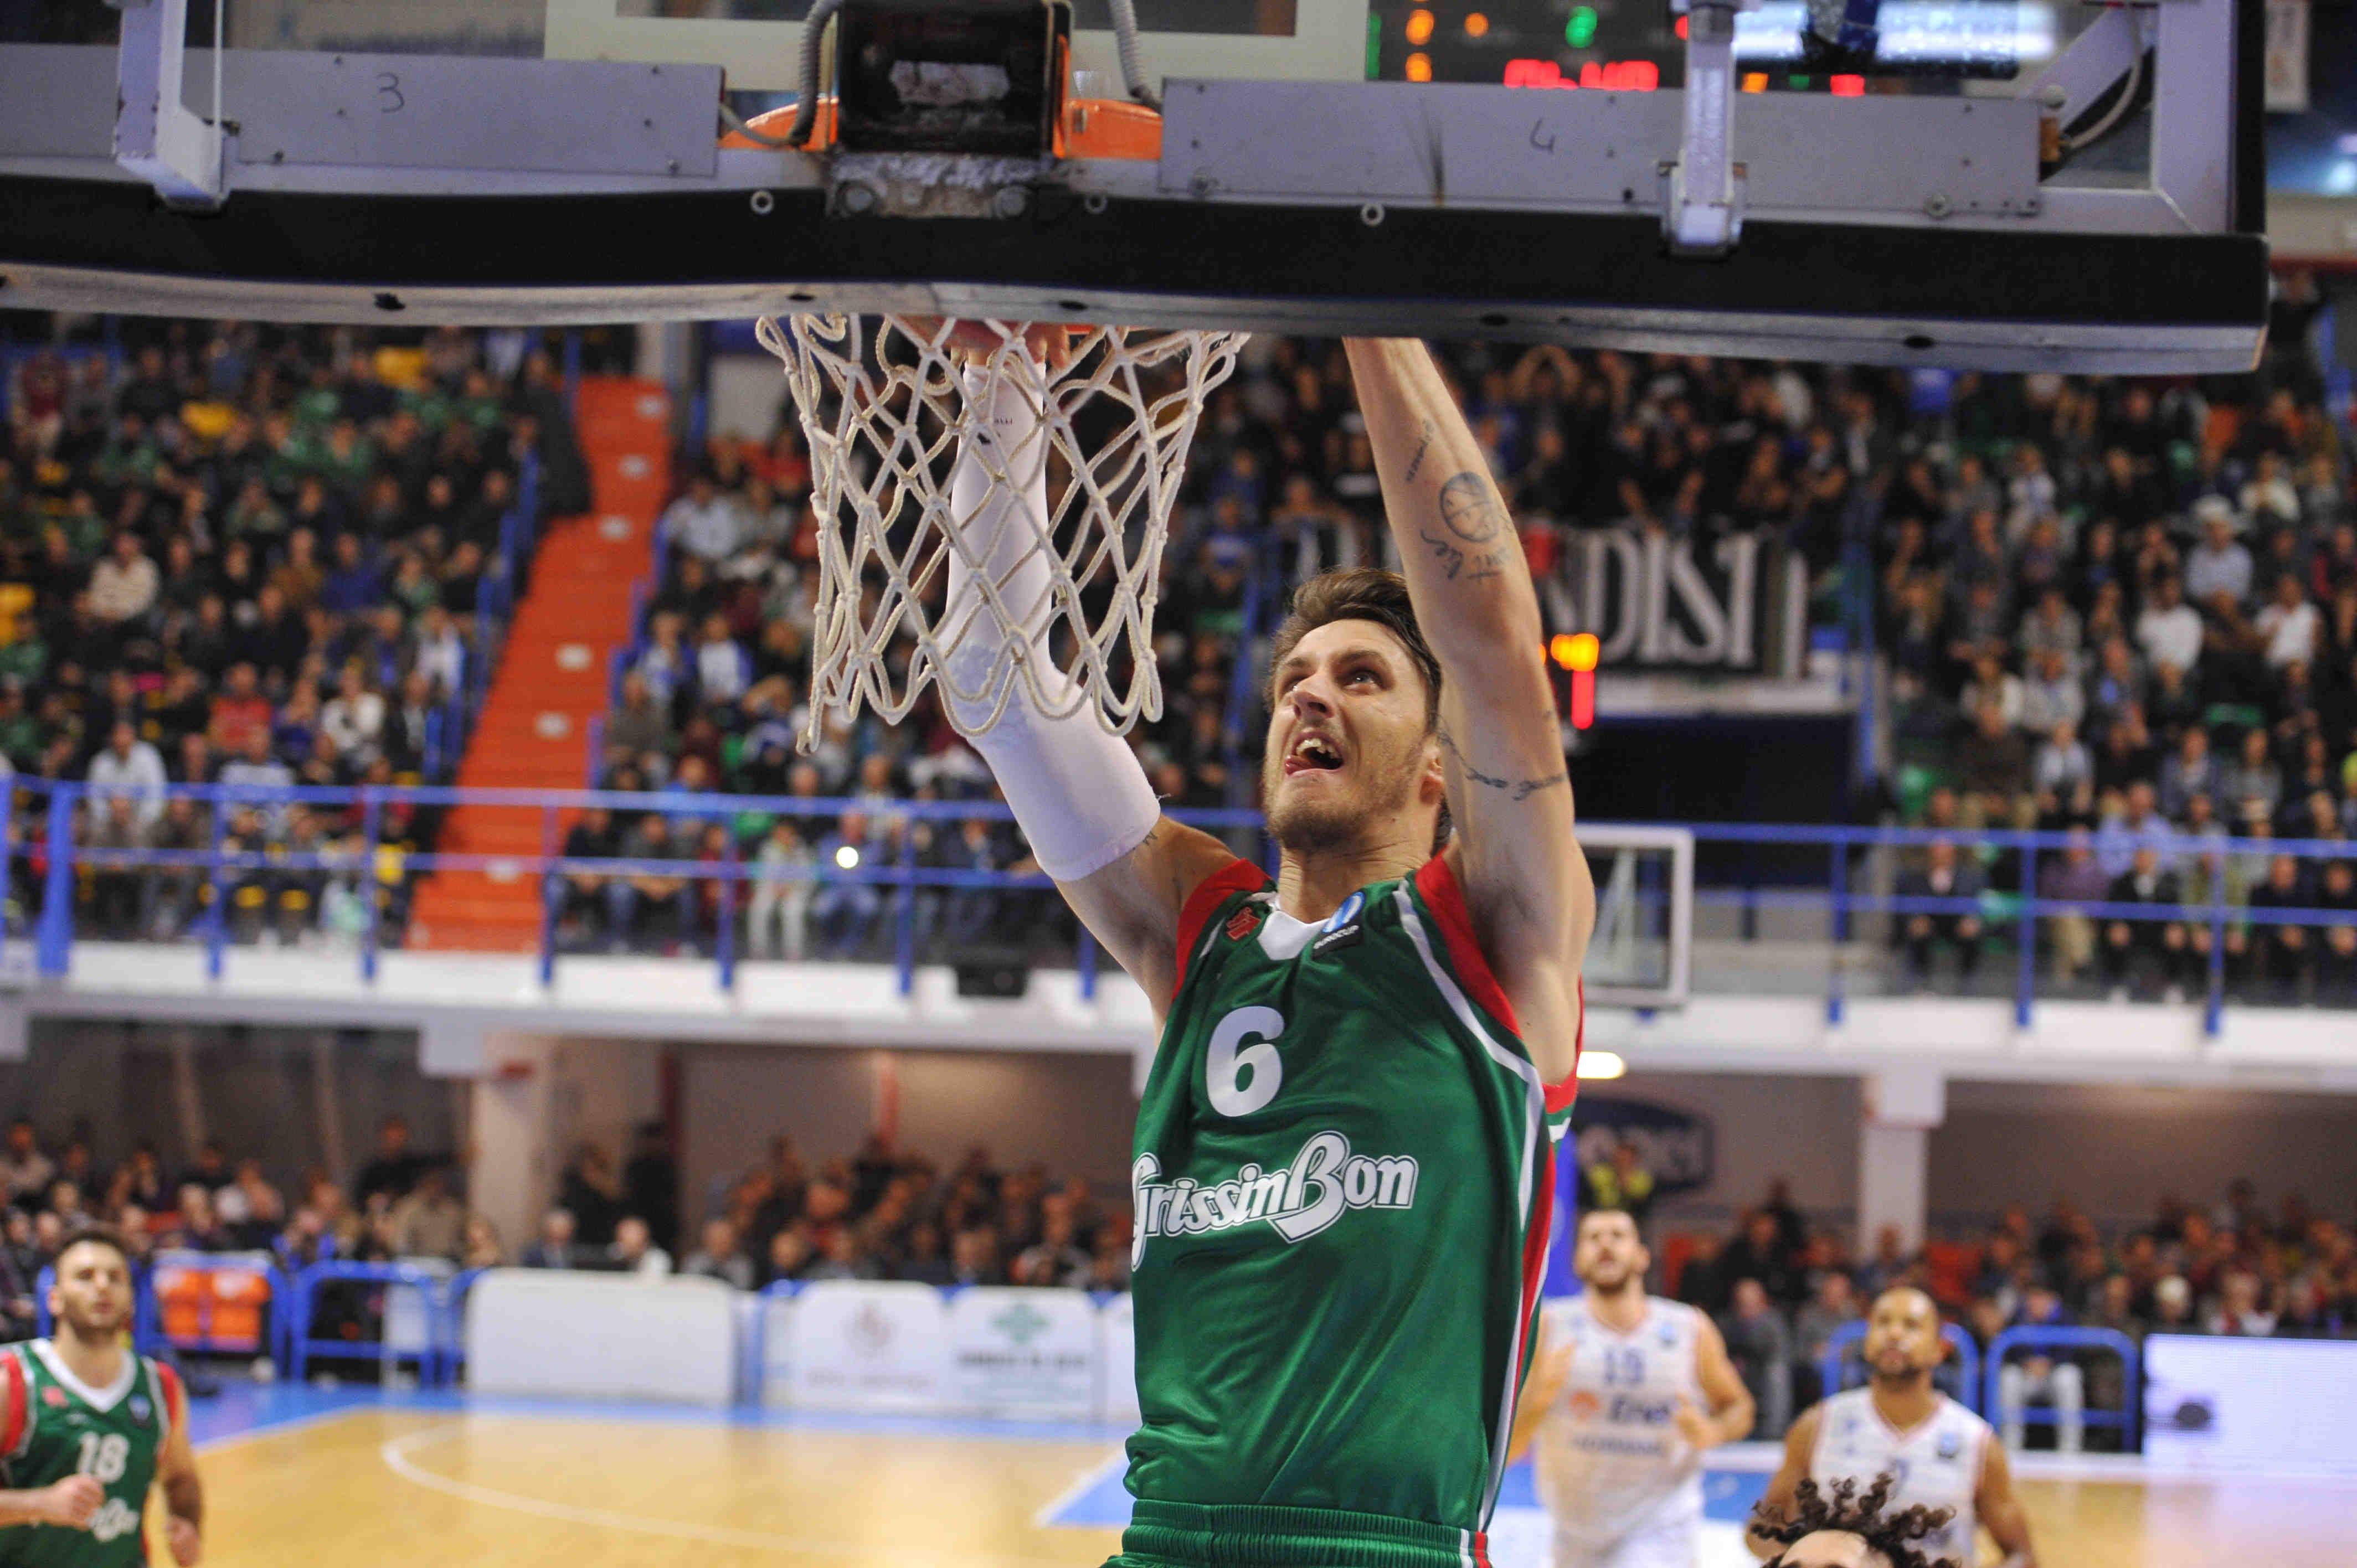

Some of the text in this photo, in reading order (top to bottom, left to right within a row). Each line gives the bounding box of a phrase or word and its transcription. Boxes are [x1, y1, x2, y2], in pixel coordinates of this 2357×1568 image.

[376, 71, 405, 114] 3
[1529, 117, 1556, 155] 4
[1205, 1005, 1285, 1117] 6
[76, 1431, 131, 1484] 18
